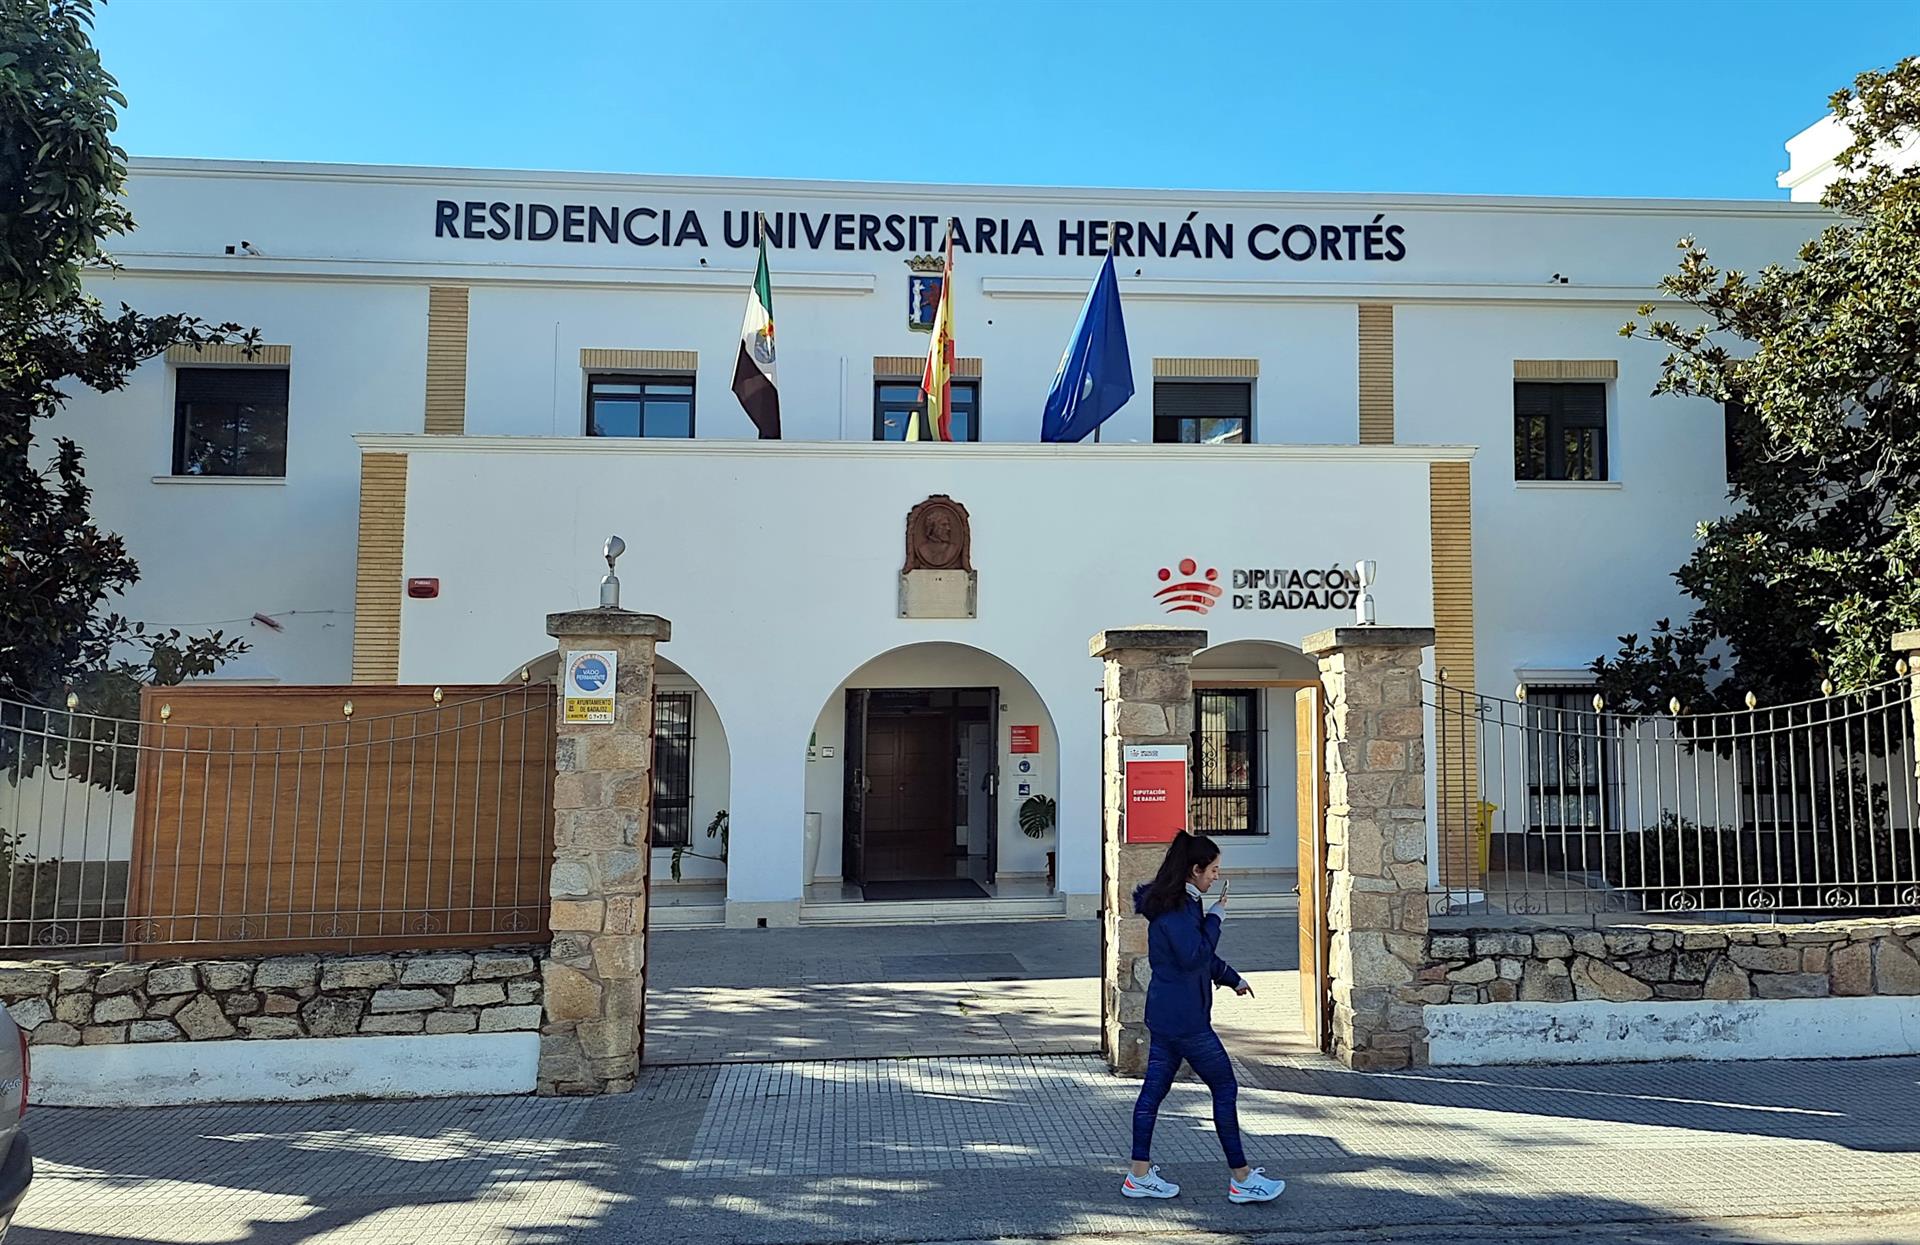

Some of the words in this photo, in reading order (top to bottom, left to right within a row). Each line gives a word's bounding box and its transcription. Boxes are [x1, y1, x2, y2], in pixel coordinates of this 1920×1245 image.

[435, 199, 709, 248] RESIDENCIA
[723, 209, 1044, 256] UNIVERSITARIA
[1058, 211, 1234, 259] HERNÁN
[1247, 213, 1406, 262] CORTÉS
[1232, 562, 1360, 589] DIPUTACIÓN
[1232, 594, 1253, 609] DE
[1258, 589, 1360, 609] BADAJOZ
